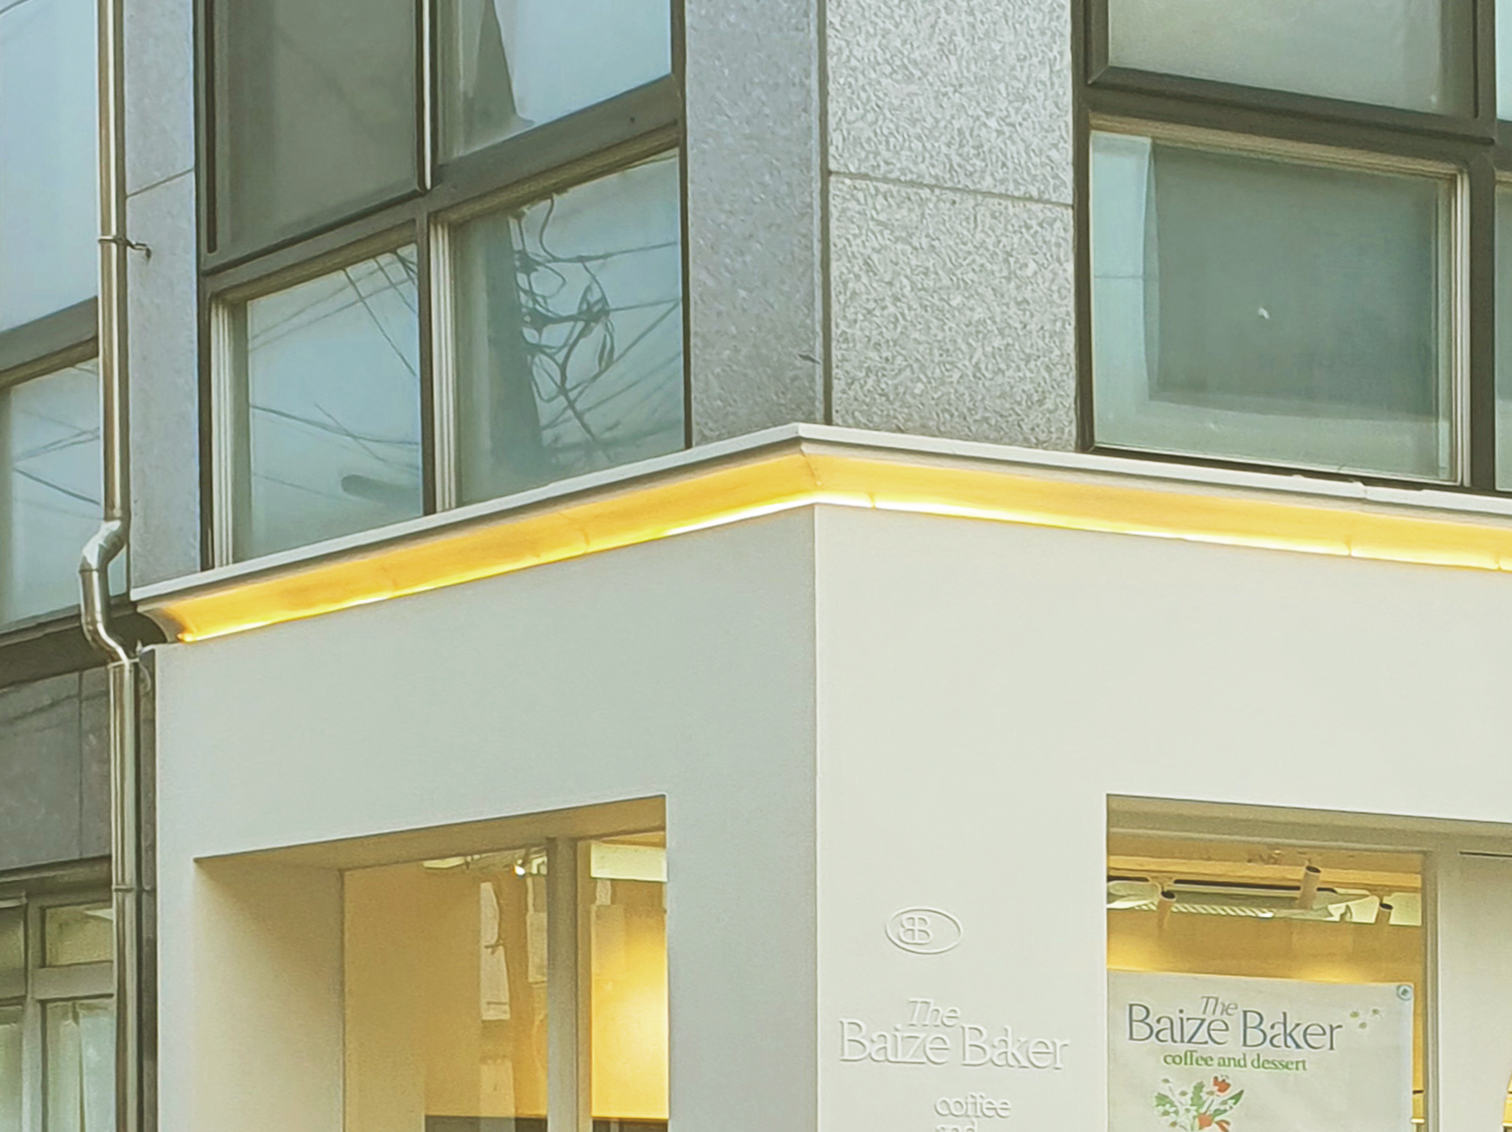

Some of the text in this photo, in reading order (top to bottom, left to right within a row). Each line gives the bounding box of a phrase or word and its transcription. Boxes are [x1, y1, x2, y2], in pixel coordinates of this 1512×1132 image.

[909, 998, 960, 1027] The
[1201, 996, 1238, 1016] The
[1127, 1003, 1343, 1051] Baize Baker
[839, 1018, 1070, 1070] Baize Baker
[1163, 1051, 1307, 1071] coffee and dessert
[934, 1093, 1011, 1118] coffee
